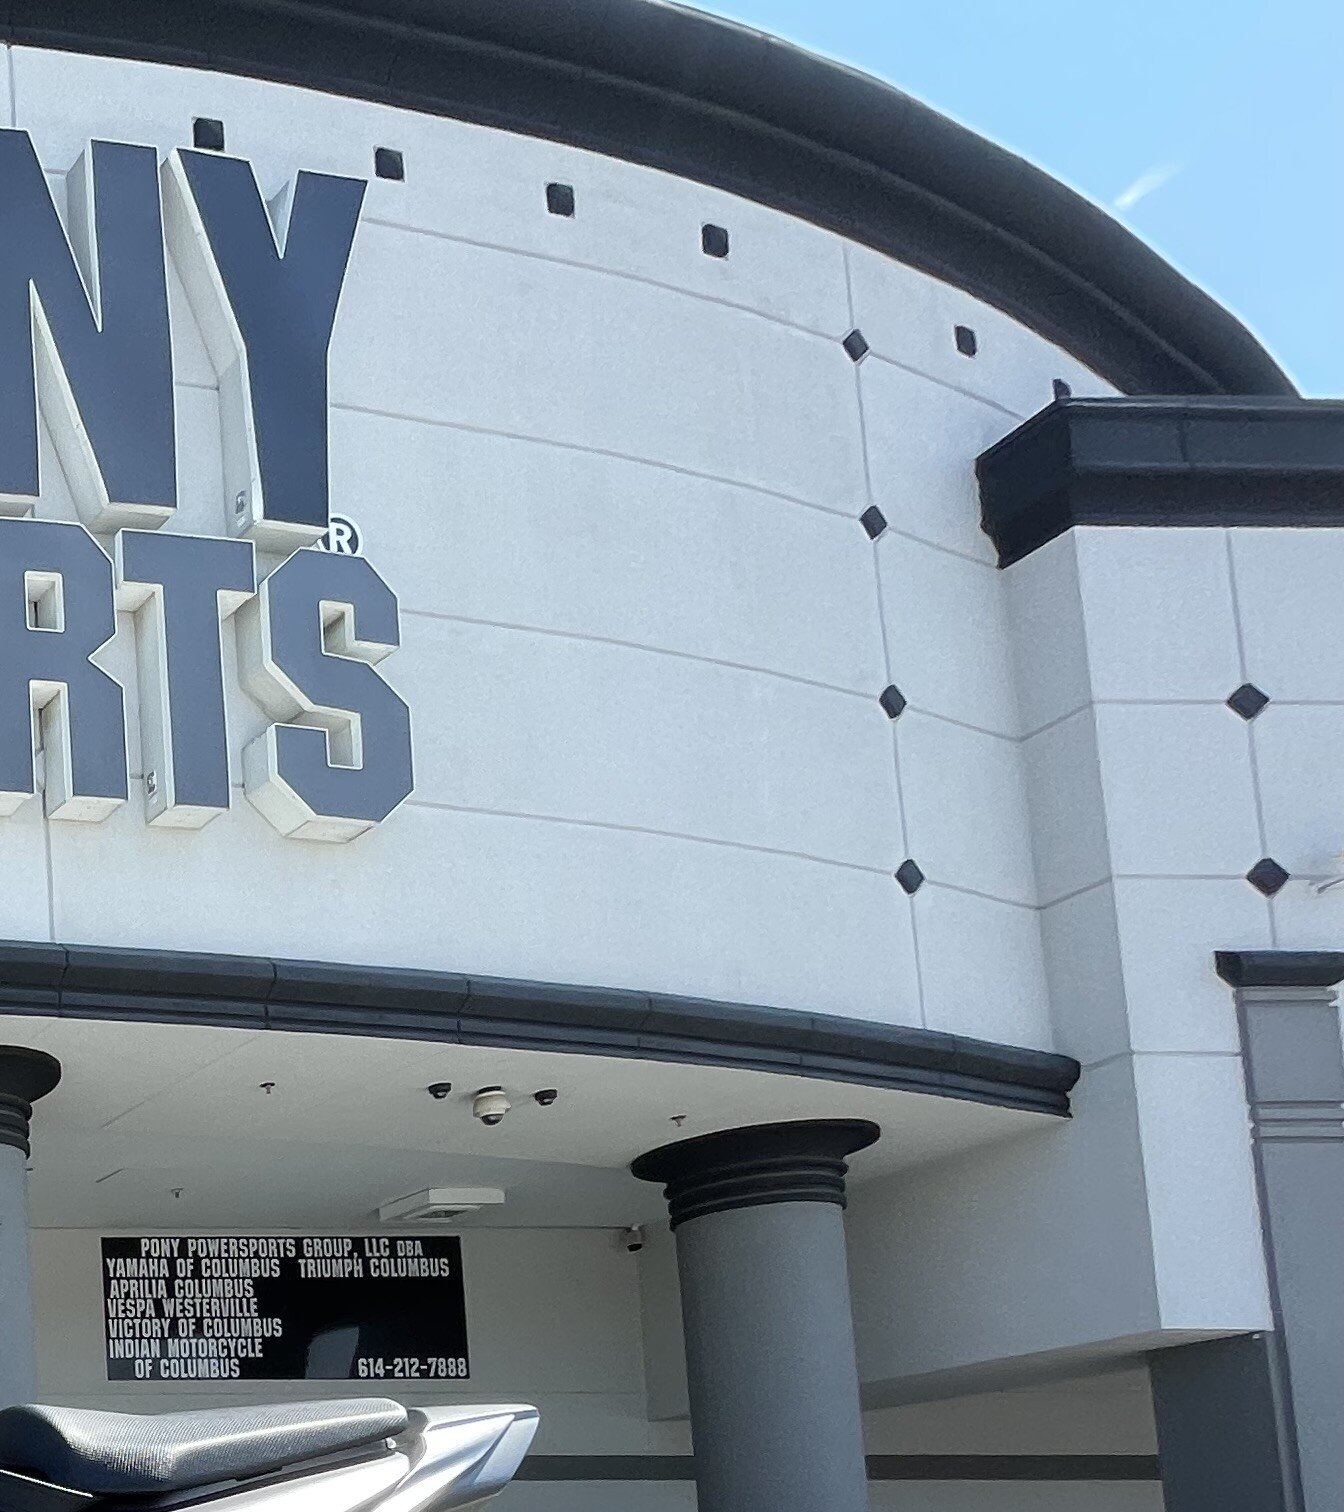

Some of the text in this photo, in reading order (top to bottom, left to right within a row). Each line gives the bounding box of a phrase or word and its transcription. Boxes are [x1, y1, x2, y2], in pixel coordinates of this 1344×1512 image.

[140, 1238, 423, 1260] PONY POWERSPORTS GROUP, LLC DBA
[106, 1258, 280, 1278] YAMAHA OF COLUMBUS
[298, 1258, 450, 1278] TRIUMPH COLUMBUS
[110, 1278, 254, 1299] APRILIA COLUMBUS
[107, 1298, 259, 1318] VESPA WESTERVILLE
[108, 1318, 283, 1338] VICTORY OF COLUMBUS
[109, 1338, 263, 1358] INDIAN MOTORCYCLE
[134, 1358, 240, 1379] OF COLUMBUS
[358, 1357, 468, 1378] 614-212-7888
